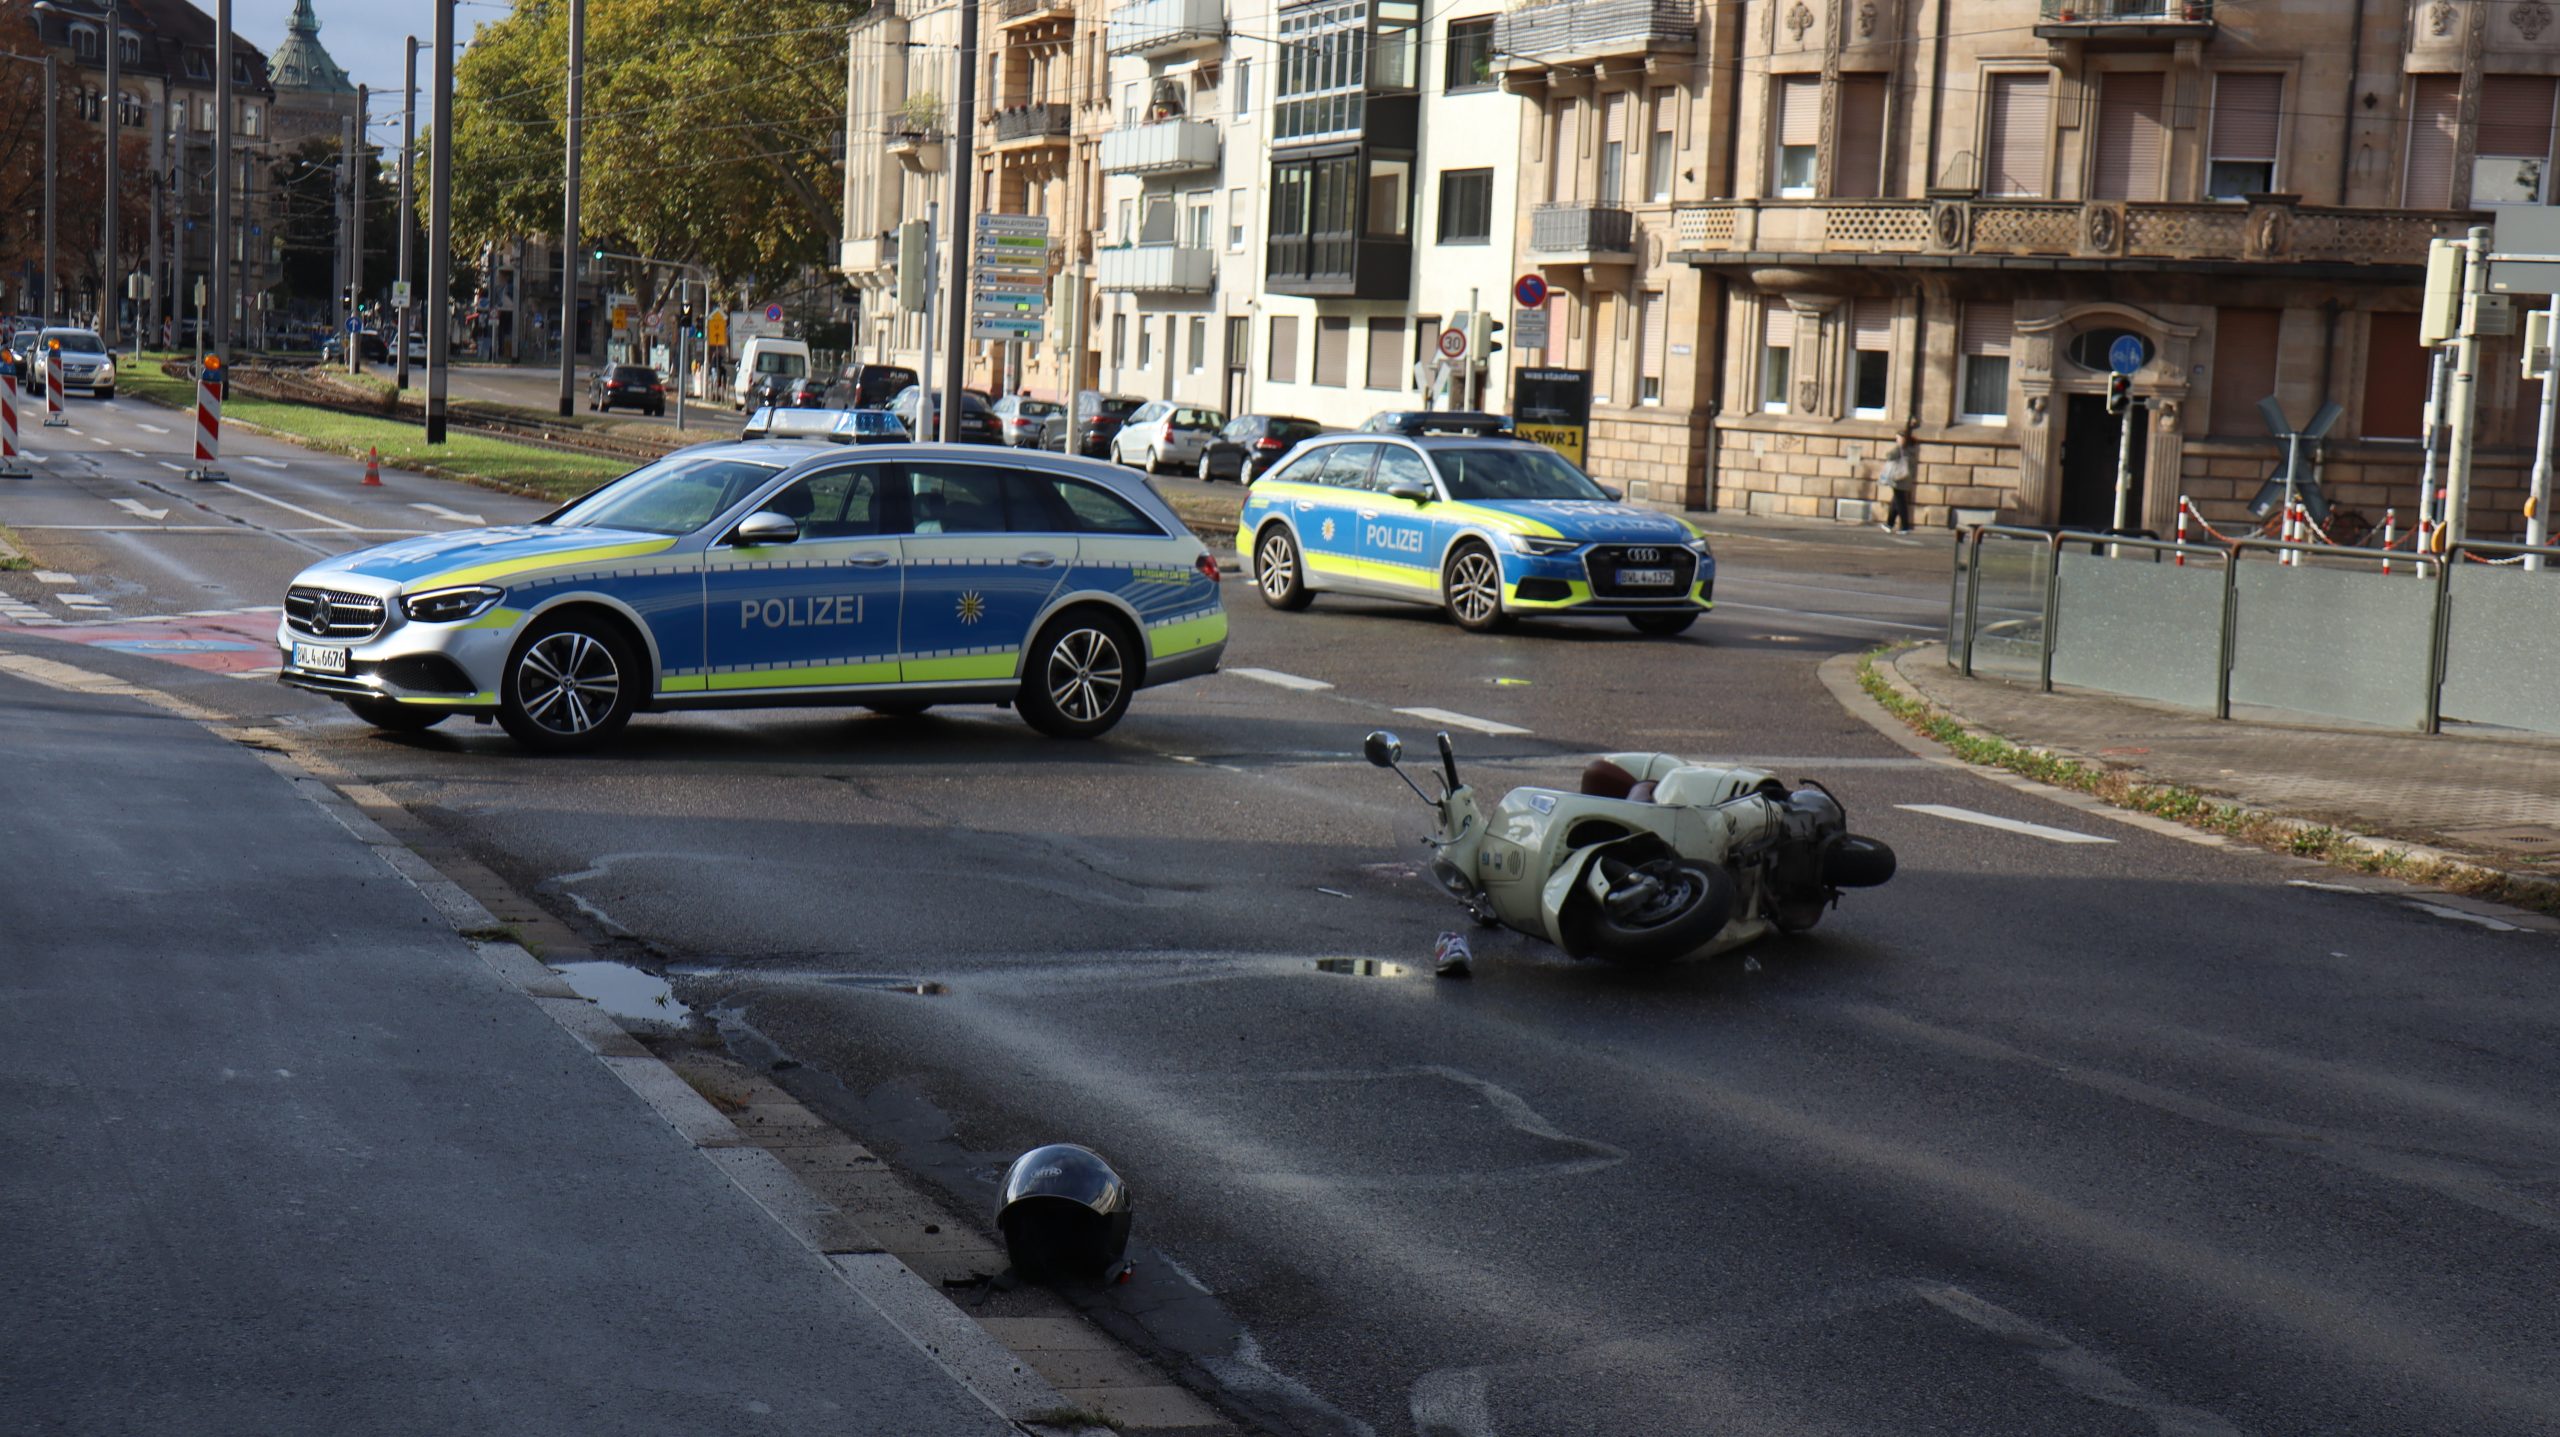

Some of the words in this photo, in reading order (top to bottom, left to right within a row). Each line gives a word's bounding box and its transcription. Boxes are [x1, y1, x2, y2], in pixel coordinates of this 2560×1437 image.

[1444, 336, 1461, 351] 30
[1366, 524, 1424, 553] POLIZEI
[741, 594, 863, 629] POLIZEI
